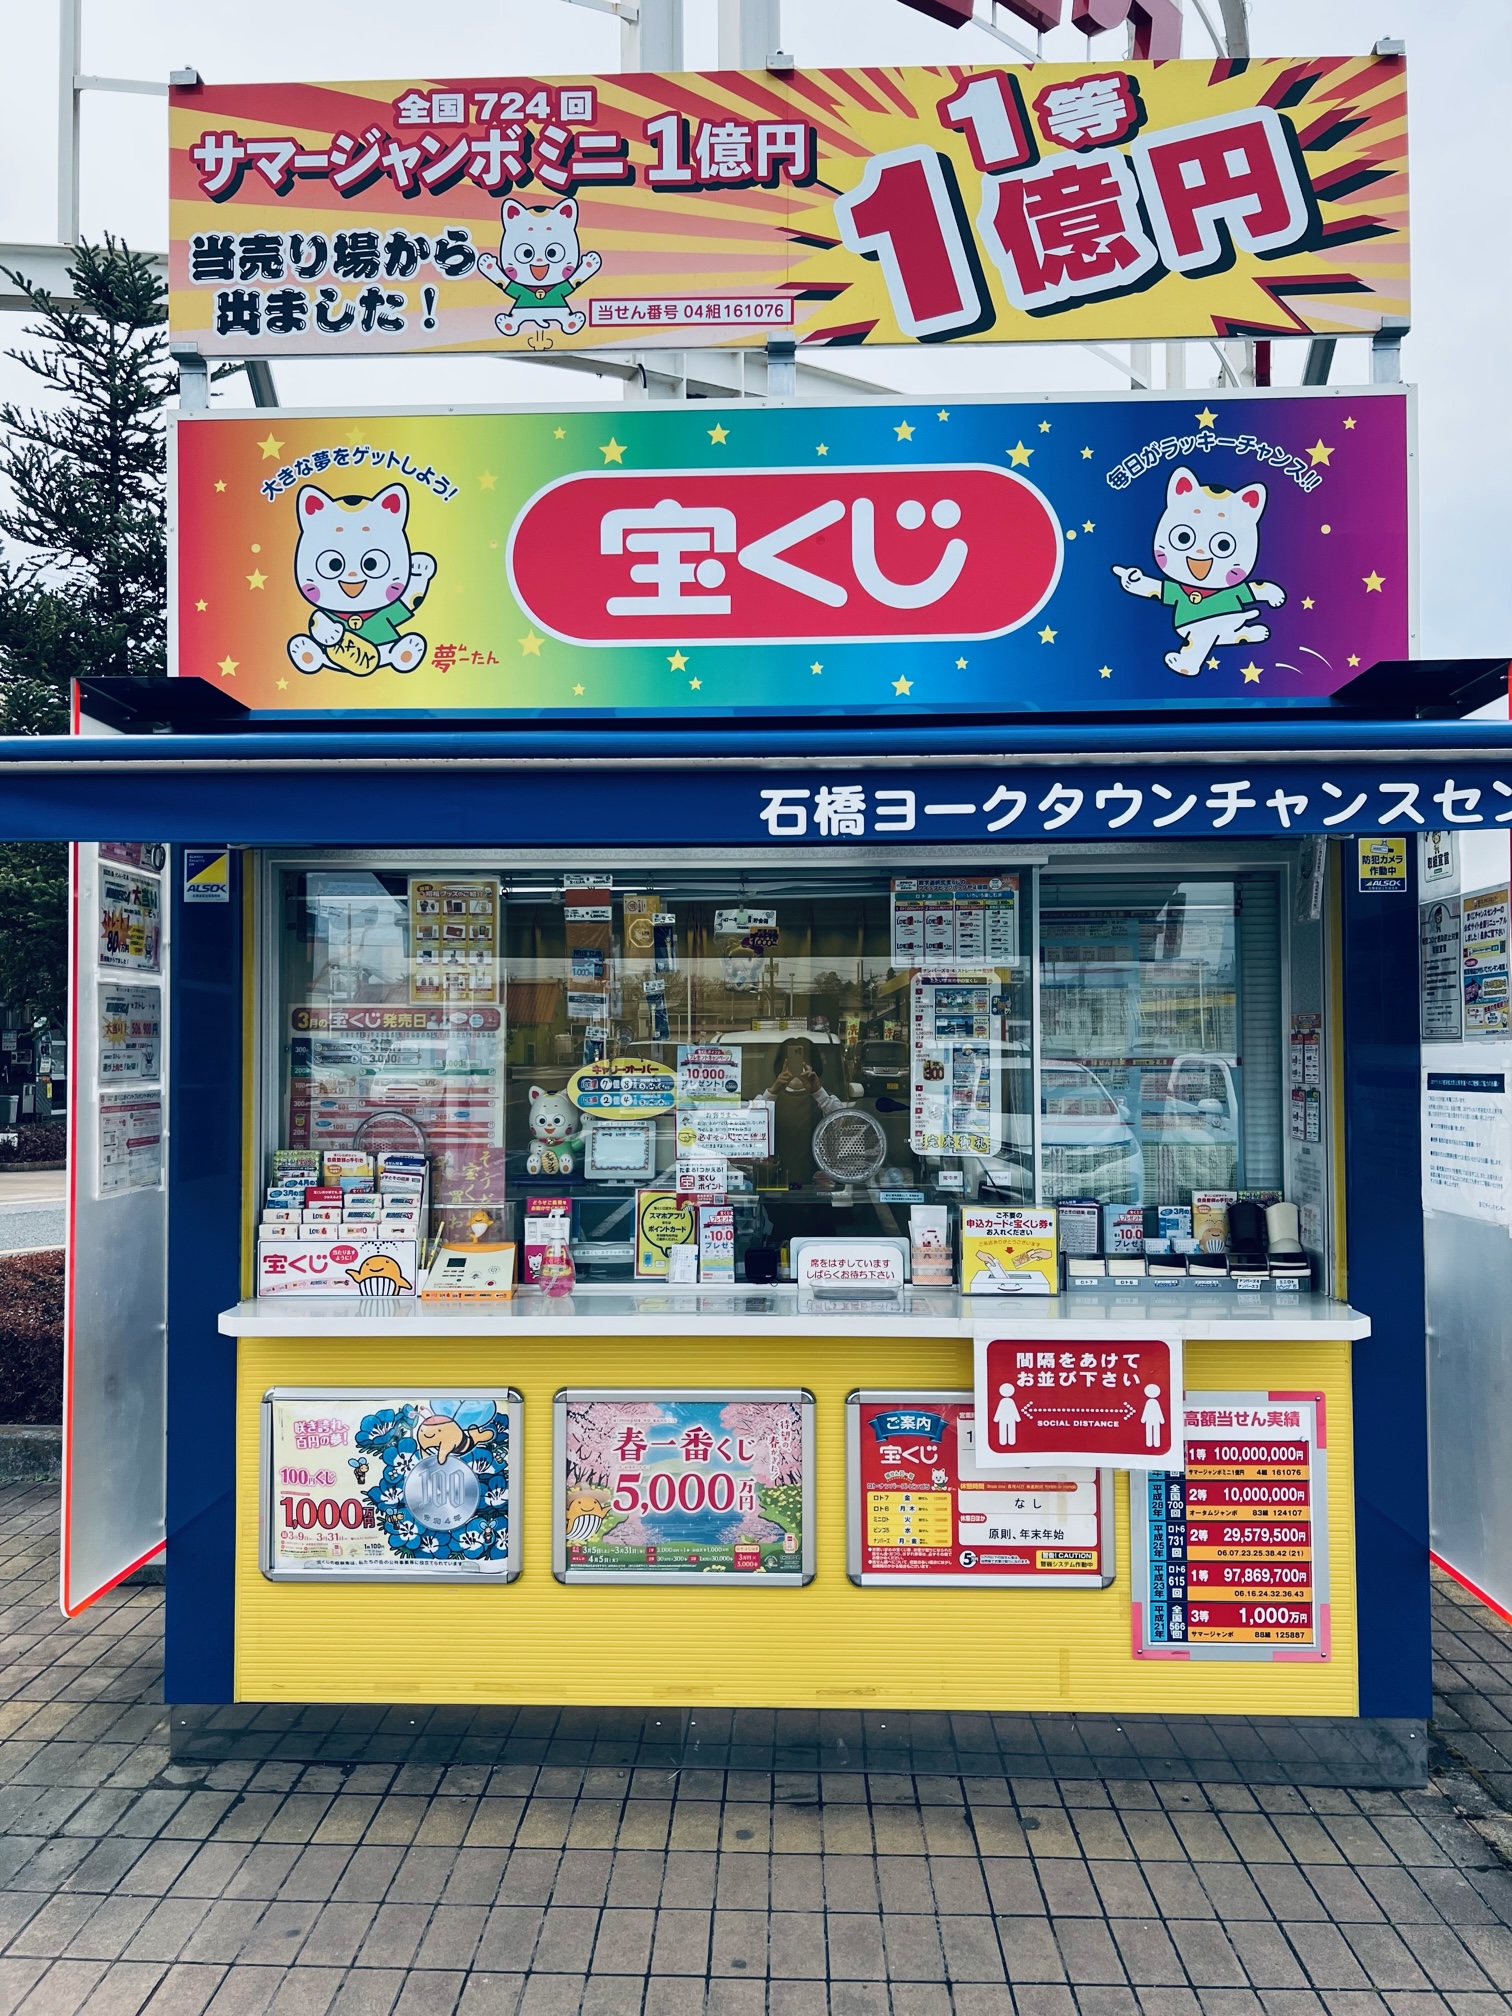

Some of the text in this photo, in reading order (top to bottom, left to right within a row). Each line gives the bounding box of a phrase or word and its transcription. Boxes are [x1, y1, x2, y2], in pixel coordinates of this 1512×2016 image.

[850, 120, 1292, 323] 1億円
[191, 229, 475, 280] 当売り場から
[216, 287, 438, 334] 出ました！
[600, 498, 968, 616] 宝くじ
[1362, 855, 1403, 865] 防犯カメラ
[1369, 866, 1396, 876] 作動中
[187, 884, 227, 893] ALSOK
[592, 1064, 659, 1075] キャリーオーバー
[263, 1254, 328, 1274] 宝くじ
[811, 1259, 891, 1268] 席をはずしています
[806, 1270, 895, 1279] しばらくお待ち下さい
[1016, 1352, 1141, 1369] 間隔をあけて
[1016, 1371, 1141, 1388] お並び下さい
[886, 1416, 931, 1431] ご案内
[1073, 1420, 1120, 1428] DISTANCE
[1183, 1411, 1301, 1428] 高額当せん実績
[612, 1426, 755, 1462] 春一番くじ
[879, 1445, 939, 1465] 宝くじ
[1189, 1446, 1304, 1462] 1等 100,000,000円
[280, 1468, 337, 1487] 100円くじ
[418, 1468, 465, 1509] 100
[612, 1472, 755, 1515] 5,000万円
[1189, 1487, 1305, 1502] 2等 10,000,000円
[280, 1497, 376, 1530] 1,000万円
[423, 1514, 462, 1525] 令和4年
[989, 1528, 1064, 1540] 原則、年末年始
[1190, 1528, 1306, 1543] 2等 29,579,500円
[1191, 1568, 1307, 1583] 1等 97,869,700円
[1191, 1608, 1307, 1624] 3等 1,000万円
[1275, 1631, 1305, 1639] 125887
